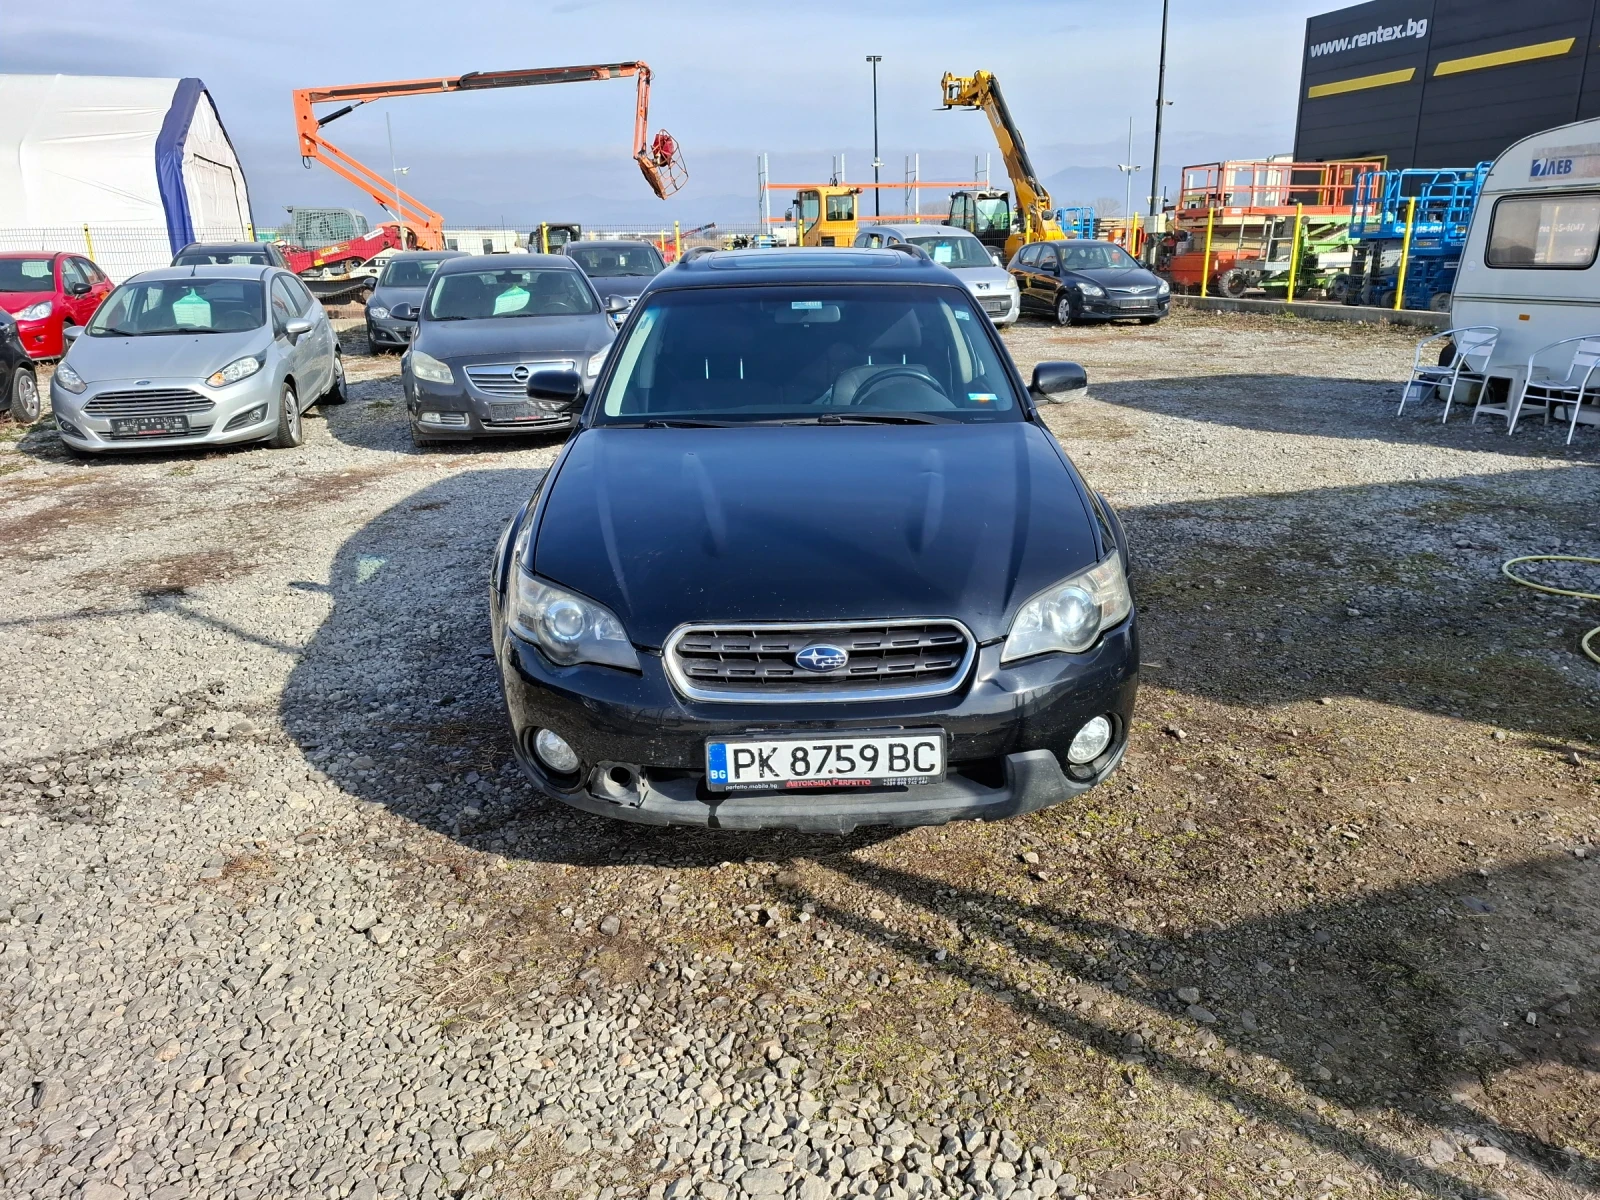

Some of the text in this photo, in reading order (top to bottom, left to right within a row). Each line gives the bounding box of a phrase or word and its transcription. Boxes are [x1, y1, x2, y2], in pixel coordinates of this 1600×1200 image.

[1310, 18, 1427, 57] www.rentex.bg
[711, 769, 726, 779] BG
[733, 741, 936, 779] PK 8759 BC
